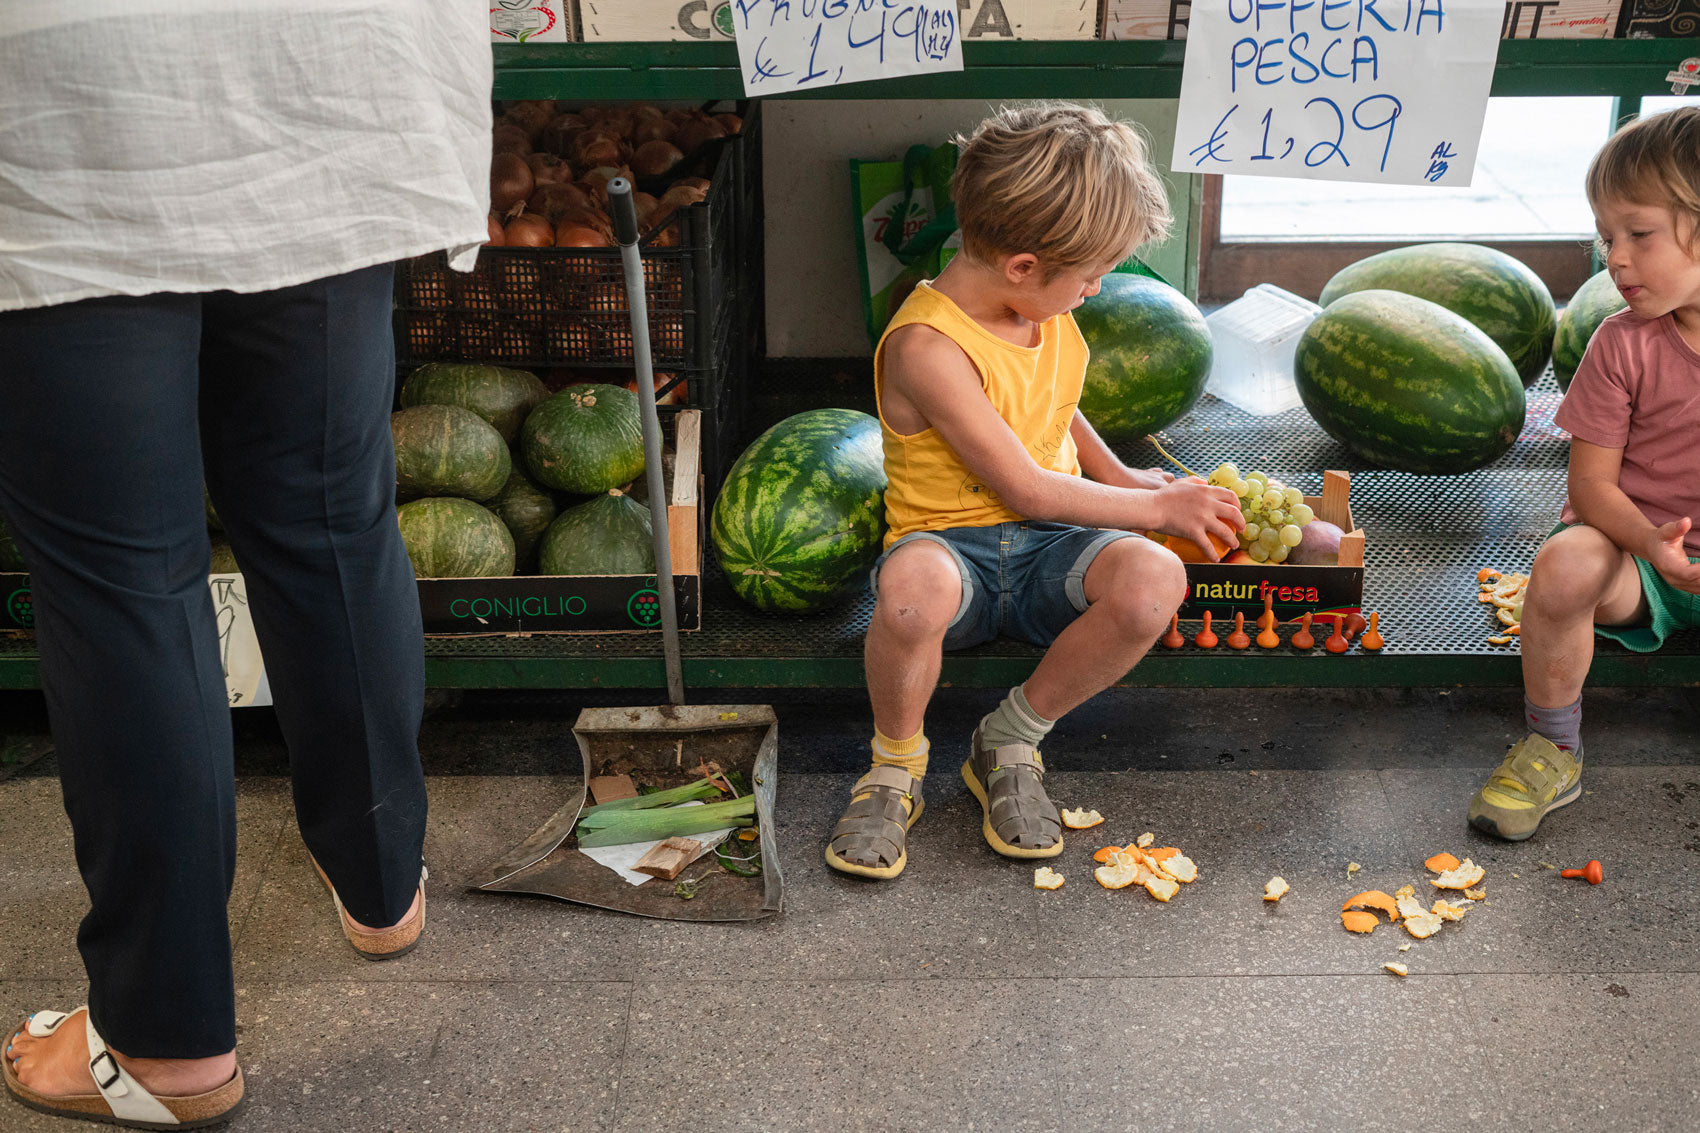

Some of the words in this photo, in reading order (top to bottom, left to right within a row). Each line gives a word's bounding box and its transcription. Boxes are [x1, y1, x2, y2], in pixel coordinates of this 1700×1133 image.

[1231, 31, 1378, 93] PESCA
[1430, 141, 1458, 159] AL
[450, 595, 587, 618] CONIGLIO
